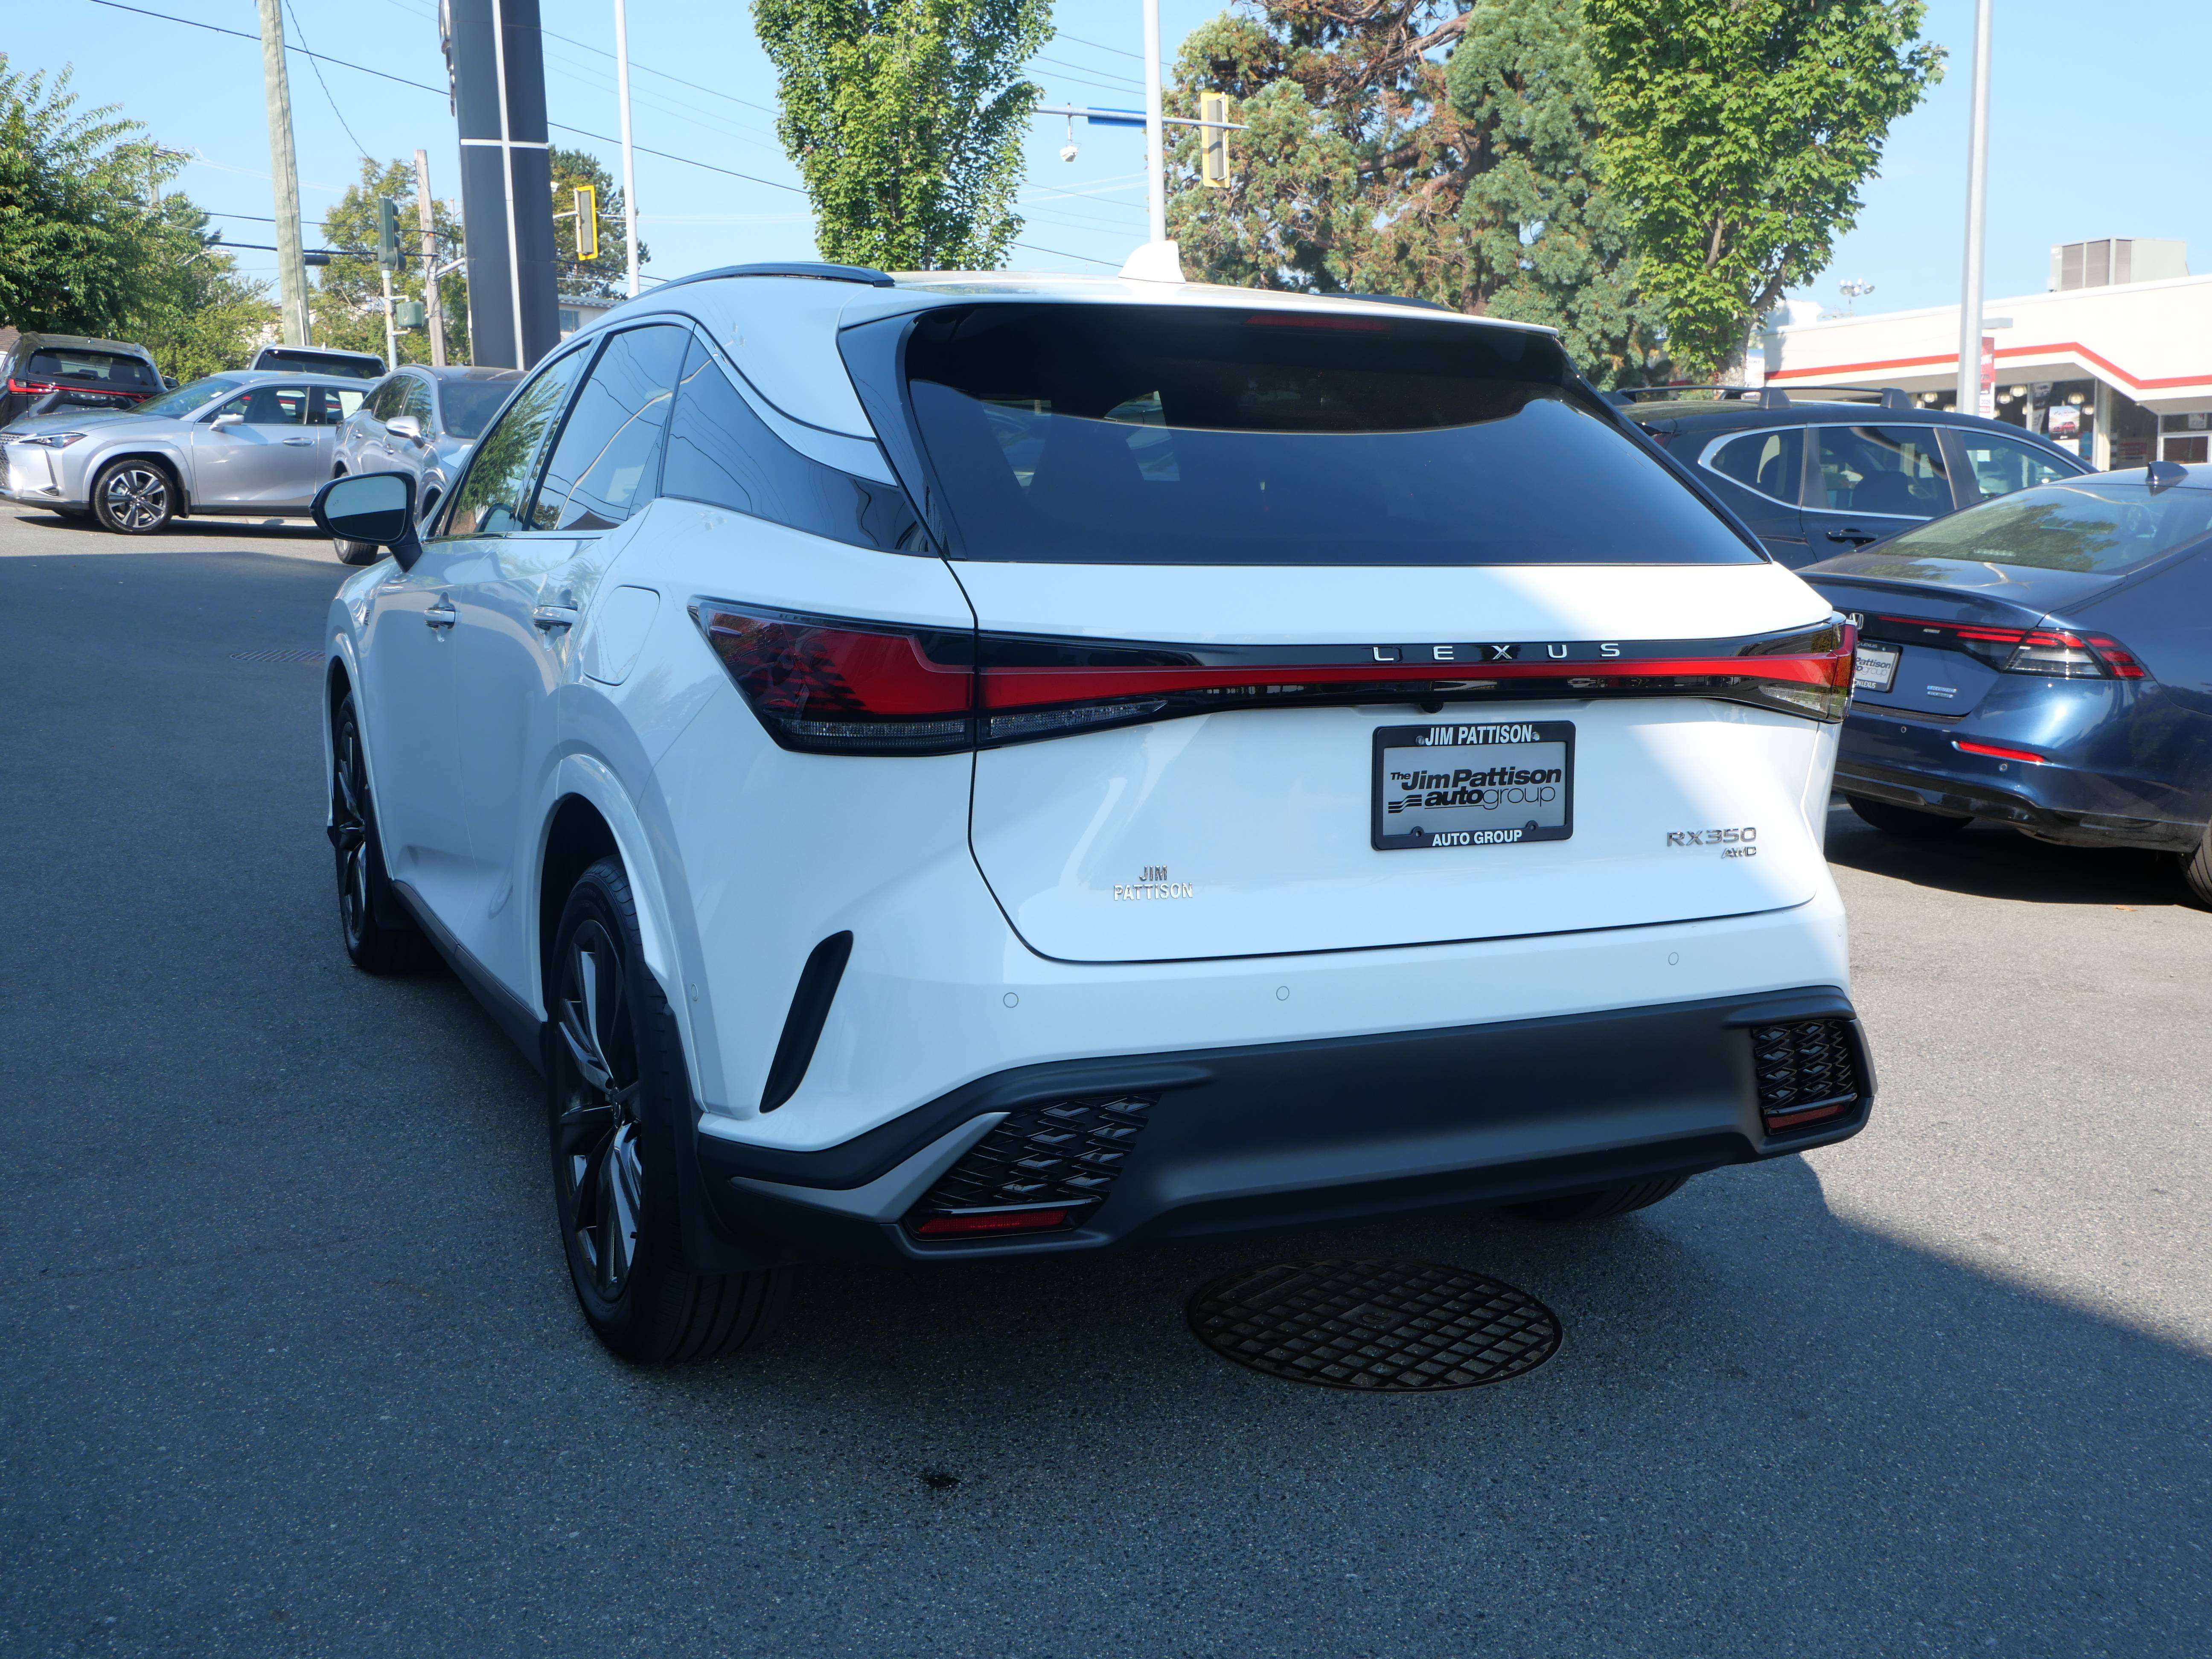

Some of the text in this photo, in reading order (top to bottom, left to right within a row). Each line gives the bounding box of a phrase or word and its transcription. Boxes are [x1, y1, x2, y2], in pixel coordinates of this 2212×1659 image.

[1373, 643, 1620, 661] LEXUS
[1862, 681, 1877, 689] LEXUS
[1425, 725, 1533, 746] JIM PATTISON
[1390, 772, 1411, 780] The
[1432, 830, 1522, 847] AUTO GROUP
[1667, 827, 1757, 847] RX350
[1721, 846, 1757, 859] AWD
[1139, 865, 1168, 882] JIM
[1113, 882, 1193, 901] PATTISON
